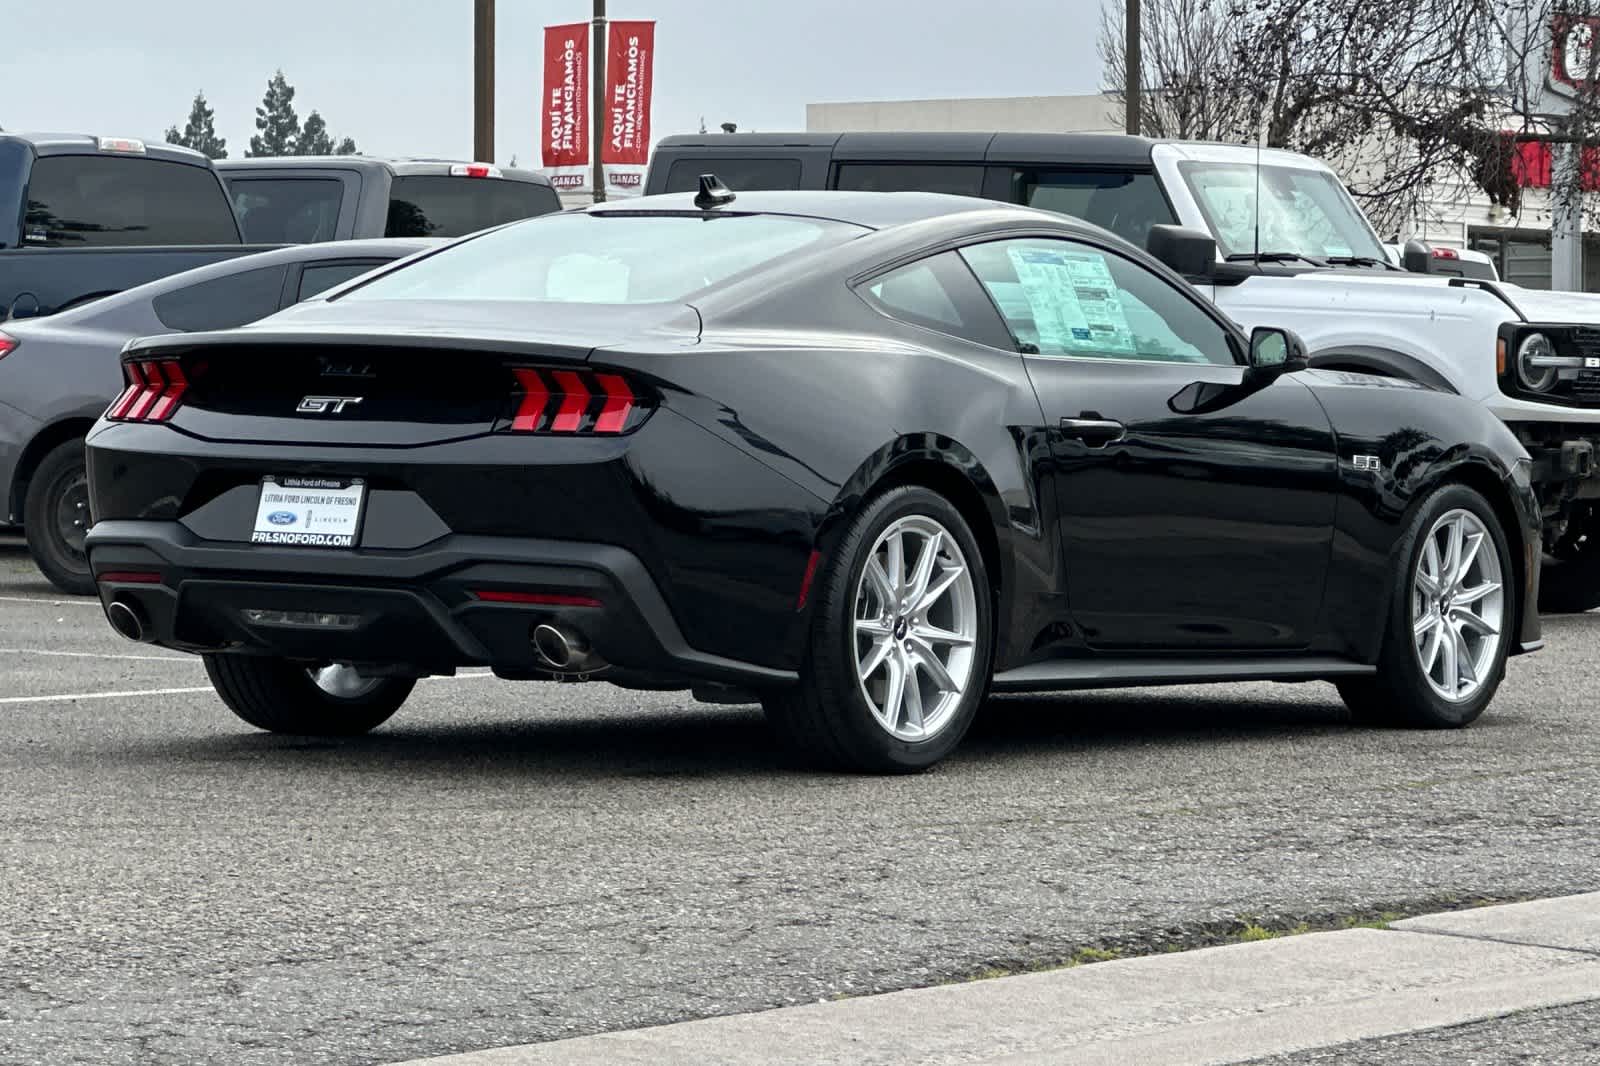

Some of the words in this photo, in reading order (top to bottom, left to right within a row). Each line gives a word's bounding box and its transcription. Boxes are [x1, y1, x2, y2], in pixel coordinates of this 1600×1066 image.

[552, 87, 562, 107] TE
[563, 39, 575, 150] FINANCIAMOS
[615, 83, 625, 104] TE
[624, 36, 639, 148] FINANCIAMOS
[549, 110, 562, 150] AQUÍ
[612, 107, 624, 148] AQUÍ
[552, 176, 583, 186] GANAS
[609, 174, 640, 184] GANAS
[296, 395, 363, 413] GT
[284, 478, 300, 486] Lithia
[301, 479, 314, 487] Ford
[321, 480, 341, 488] Fresno
[264, 494, 285, 503] LITHIA
[284, 495, 300, 504] FORD
[300, 496, 325, 505] LINCOLN
[326, 497, 333, 505] OF
[334, 497, 357, 506] FRESNO
[269, 512, 295, 524] Ford
[251, 531, 352, 546] FRESNOFORD.COM
